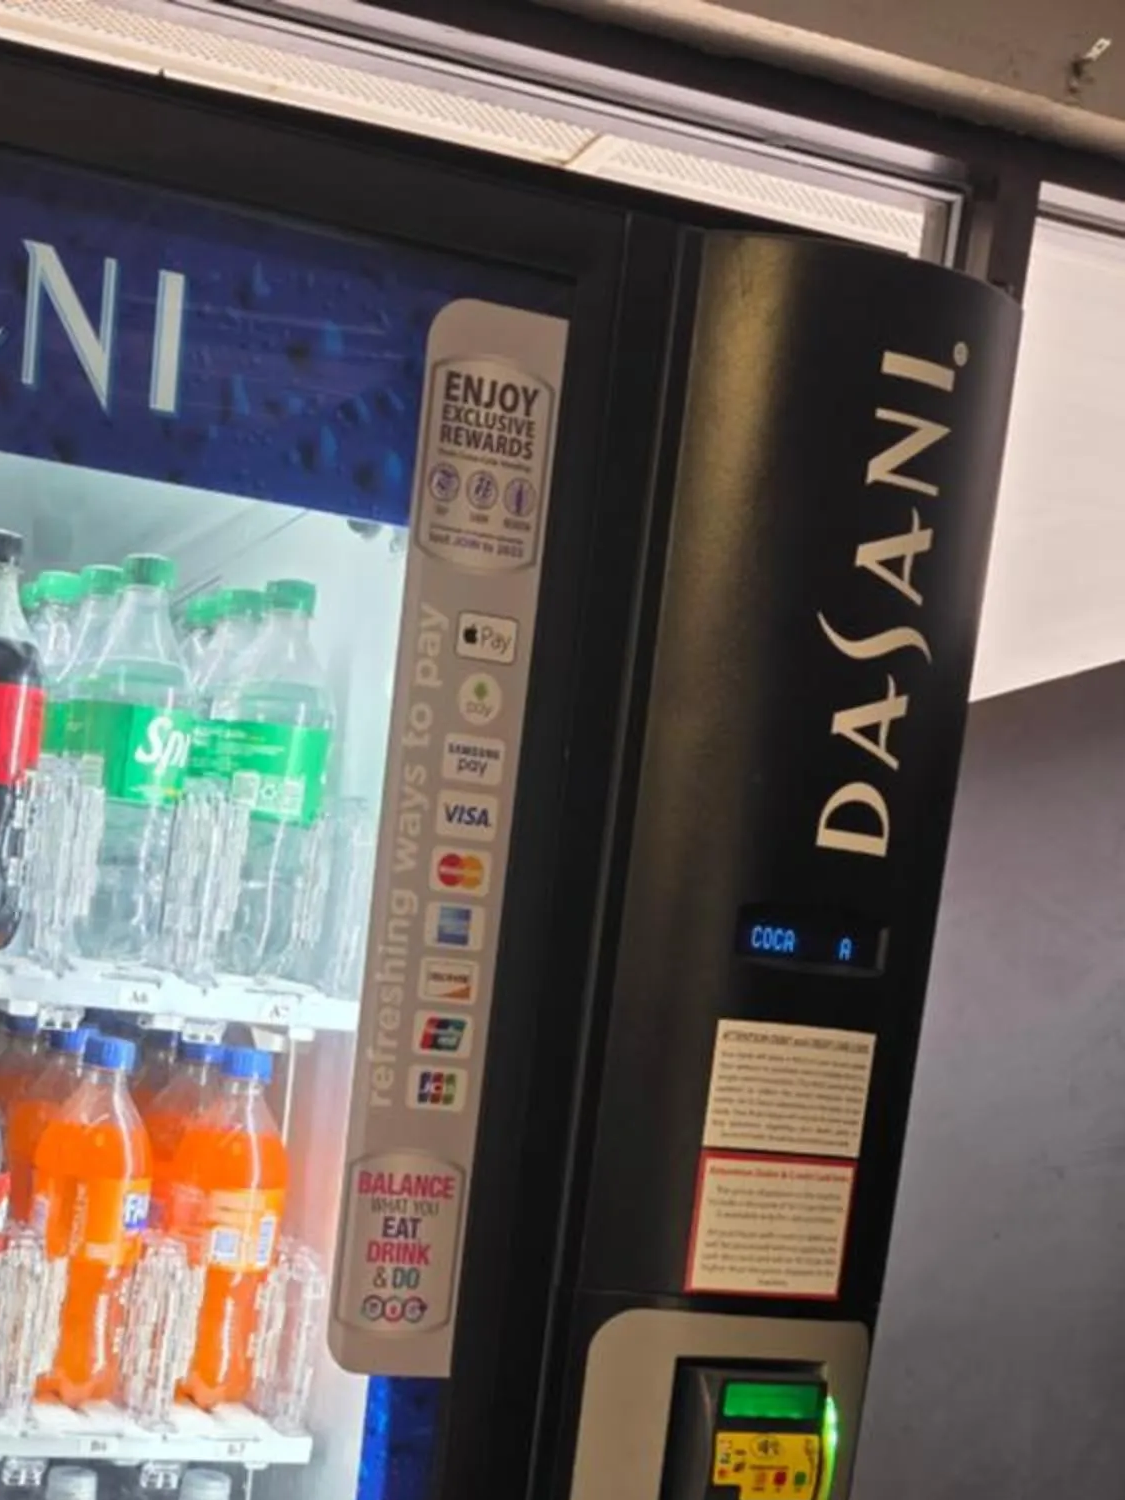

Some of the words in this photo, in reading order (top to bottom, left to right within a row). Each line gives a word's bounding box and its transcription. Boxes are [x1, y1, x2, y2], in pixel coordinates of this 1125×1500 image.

[444, 370, 539, 417] ENJOY
[442, 404, 536, 439] EXCLUSIVE
[440, 424, 534, 460] REWARDS
[816, 350, 956, 858] DASANI
[415, 603, 449, 689] pay
[481, 625, 512, 654] Pay
[402, 703, 433, 748] to
[466, 701, 493, 718] pay
[457, 758, 487, 778] pay
[394, 764, 429, 873] ways
[444, 803, 491, 827] VISA
[751, 925, 795, 952] COCA
[838, 937, 852, 961] A
[367, 888, 418, 1107] refreshing
[358, 1170, 456, 1199] BALANCE
[371, 1198, 407, 1215] WHAT
[412, 1200, 440, 1217] YOU
[382, 1216, 422, 1240] EAT
[366, 1240, 432, 1266] DRINK
[373, 1266, 387, 1288] &
[392, 1267, 420, 1290] DO
